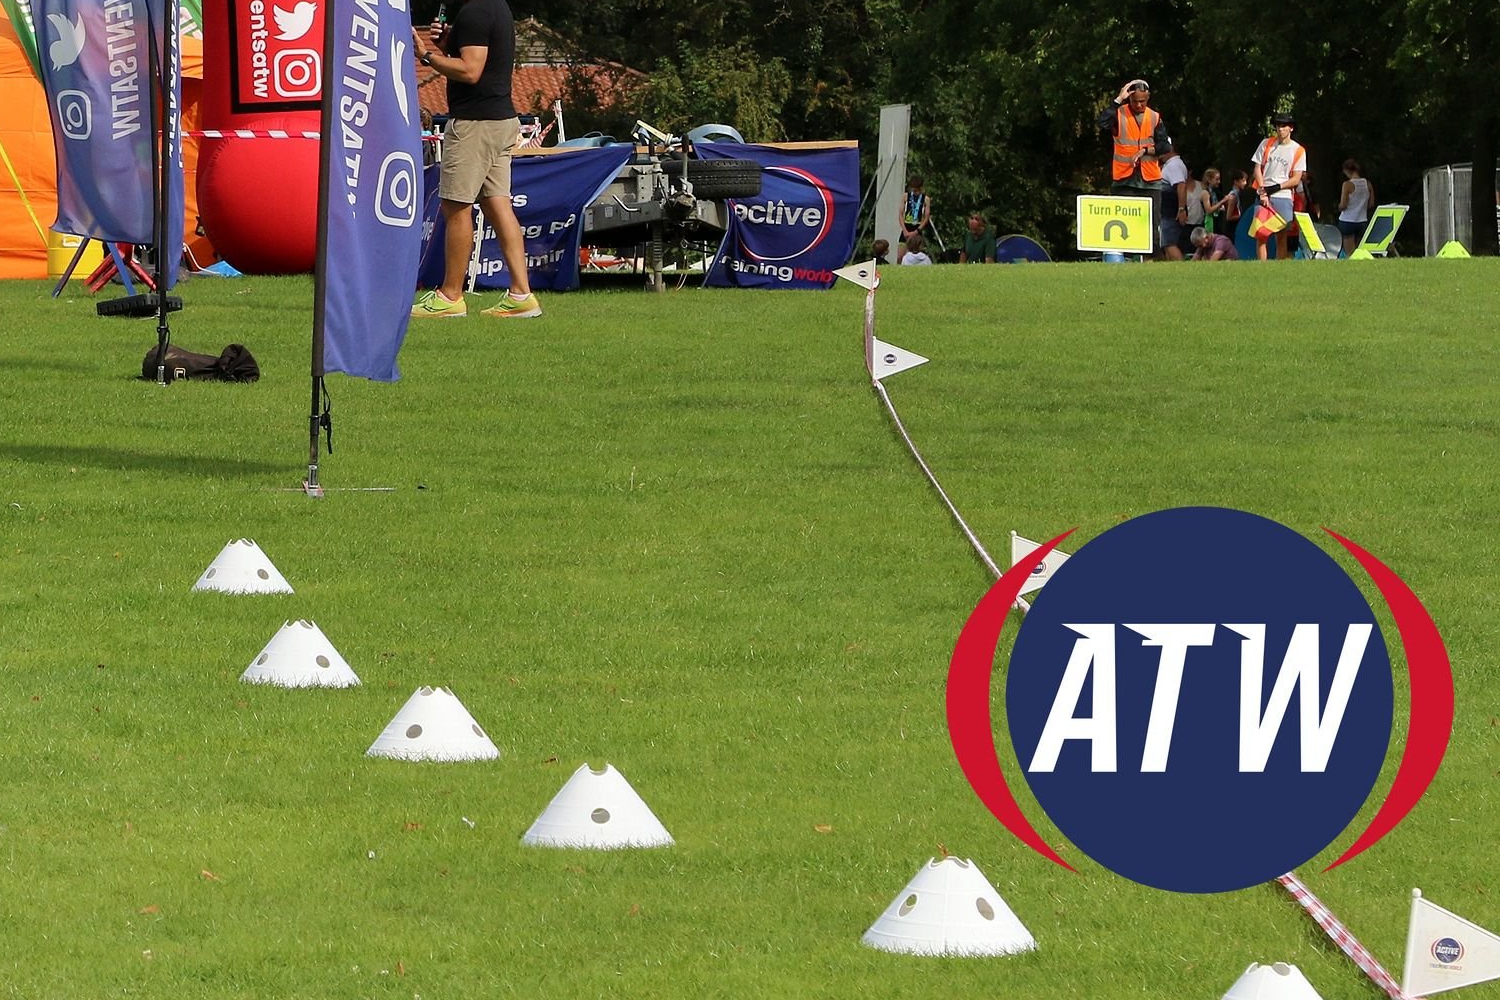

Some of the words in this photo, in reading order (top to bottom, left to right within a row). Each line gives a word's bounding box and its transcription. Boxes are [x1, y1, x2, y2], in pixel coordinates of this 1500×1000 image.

[734, 199, 821, 227] active
[1088, 204, 1111, 215] Turn
[1115, 205, 1141, 217] Point
[1436, 946, 1460, 956] ACTIVE
